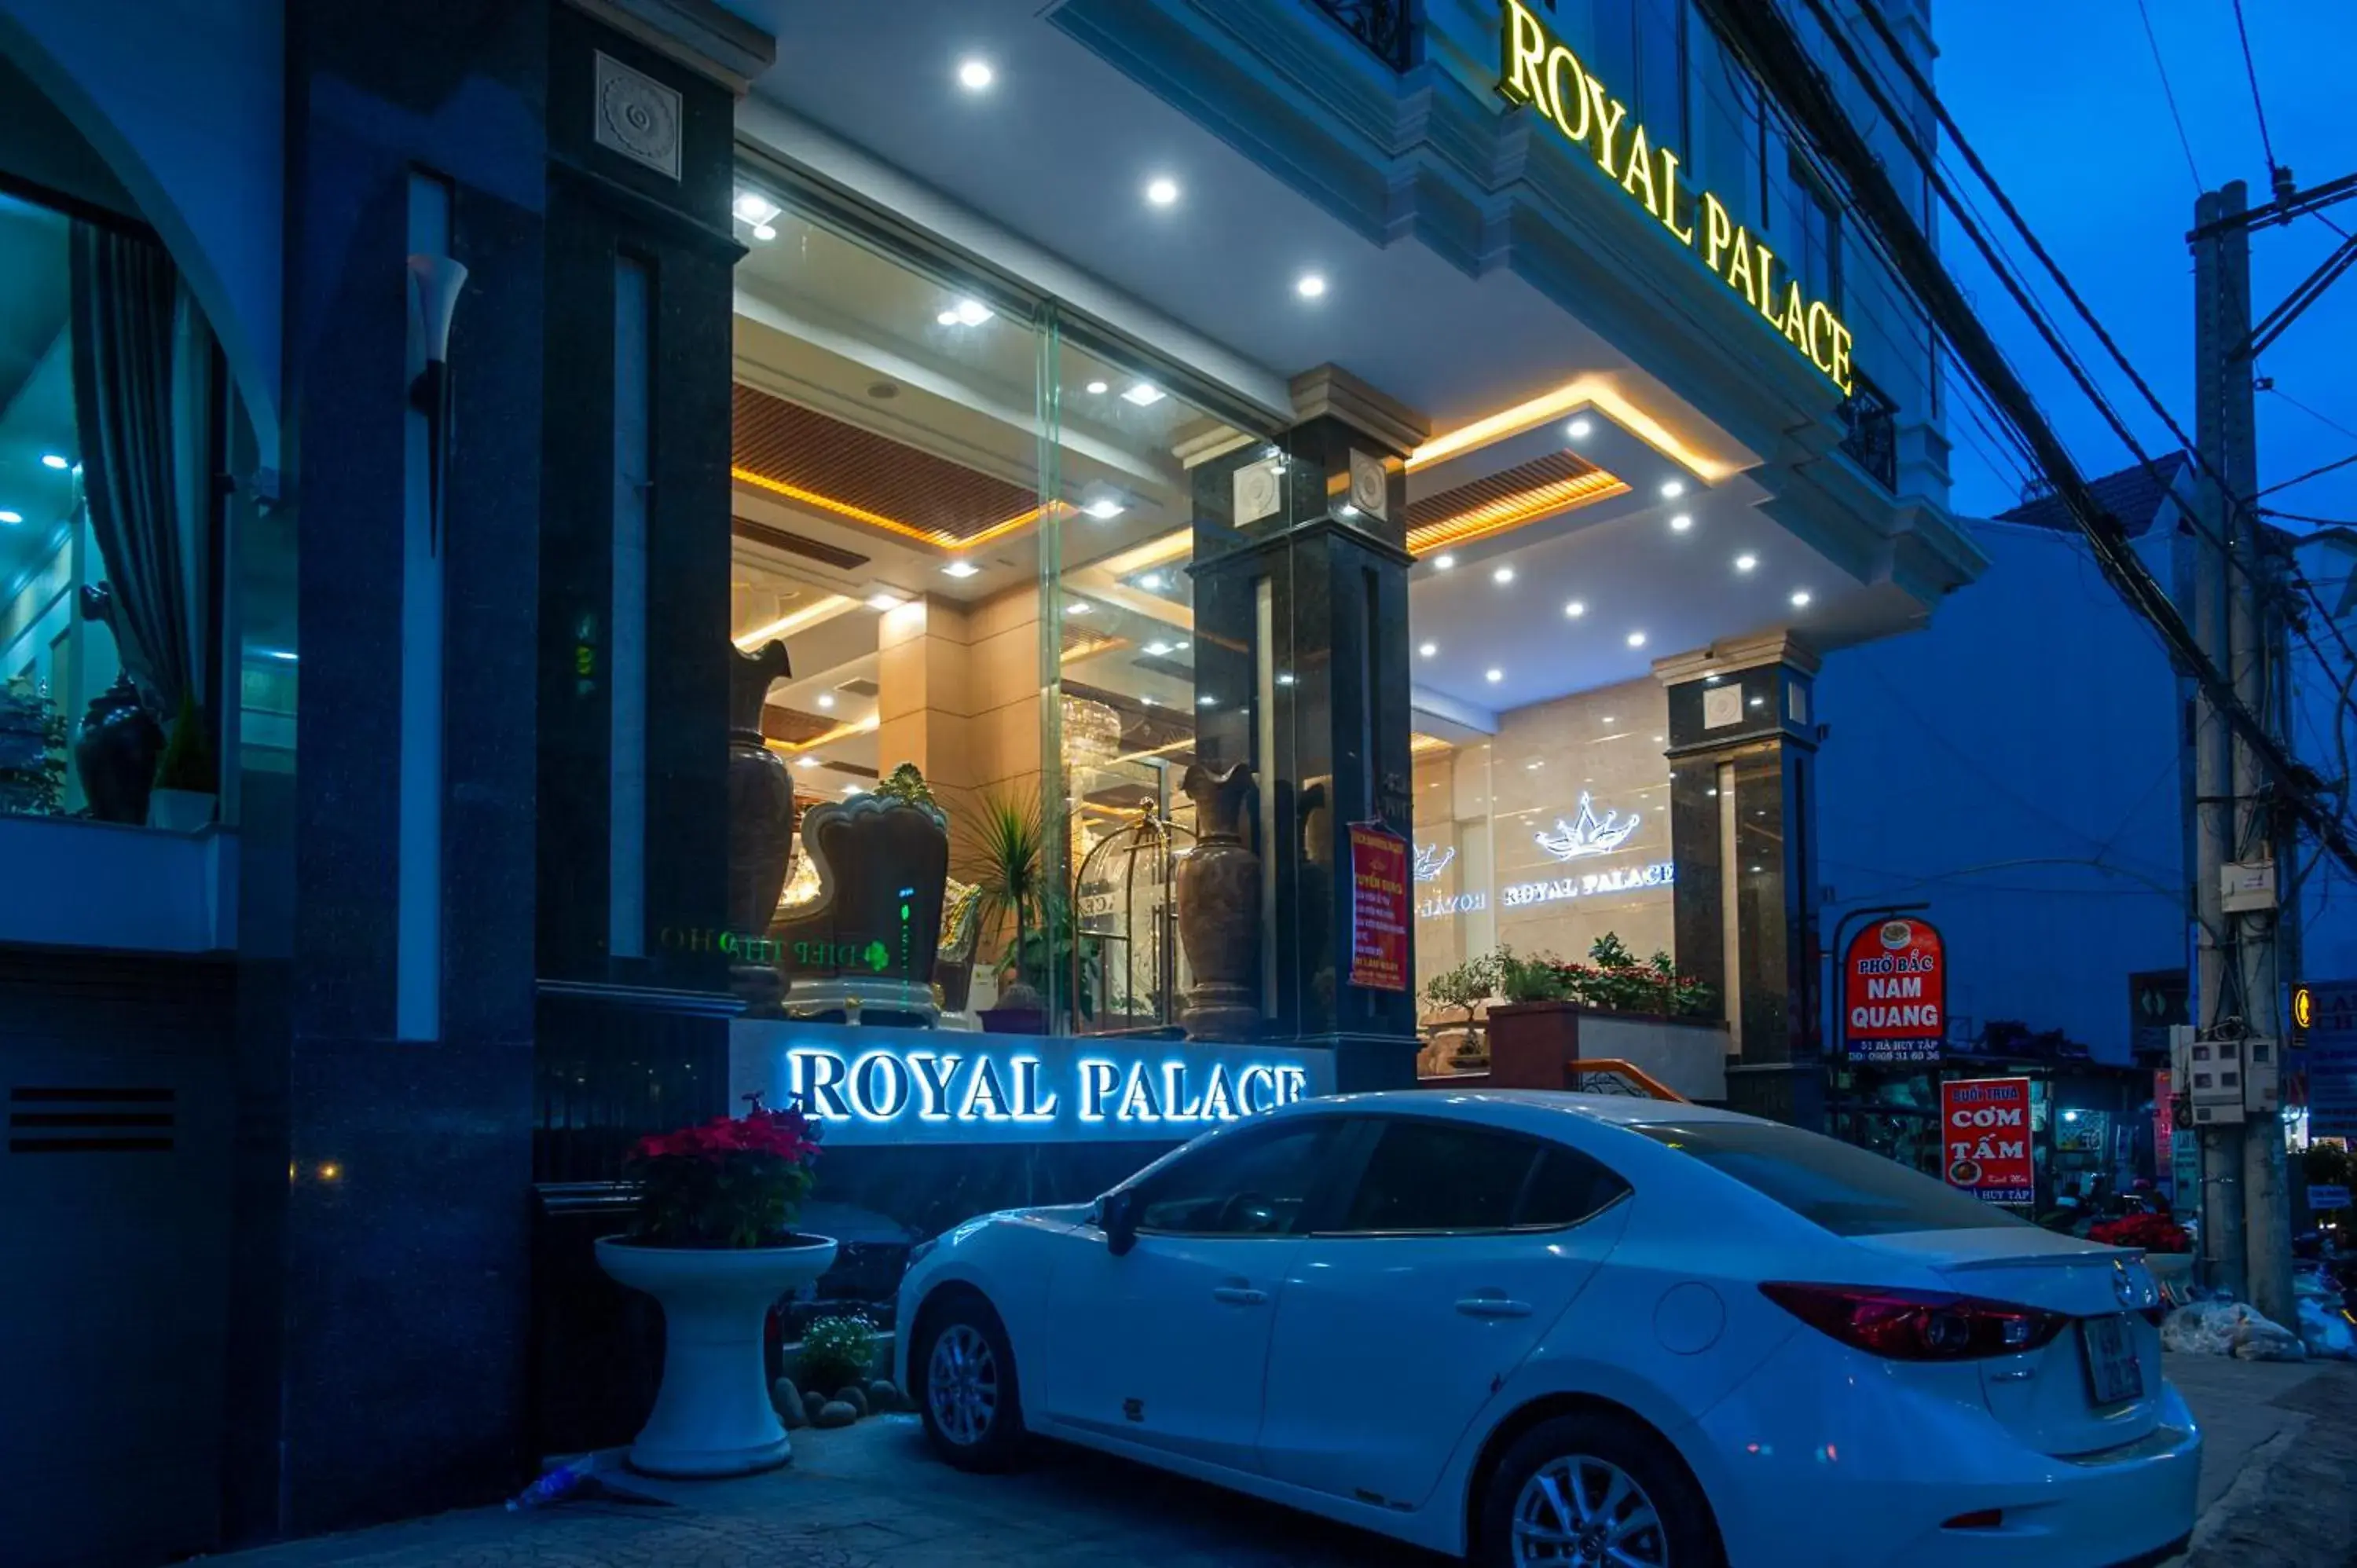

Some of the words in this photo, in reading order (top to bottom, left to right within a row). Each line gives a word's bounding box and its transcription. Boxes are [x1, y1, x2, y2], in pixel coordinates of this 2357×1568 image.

[1507, 0, 1692, 246] ROYAL
[1704, 192, 1853, 397] PALACE
[1504, 879, 1578, 906] ROYAL
[1582, 863, 1674, 895] PALACE
[1858, 952, 1894, 974] PHỞ
[1896, 949, 1934, 973] BẮC
[1868, 977, 1921, 999] NAM
[1851, 1005, 1938, 1028] QUANG
[788, 1051, 1058, 1123] ROYAL
[1079, 1060, 1307, 1123] PALACE
[1952, 1106, 2022, 1127] CƠM
[1950, 1133, 2025, 1160] TẤM
[1982, 1190, 2004, 1200] HUY
